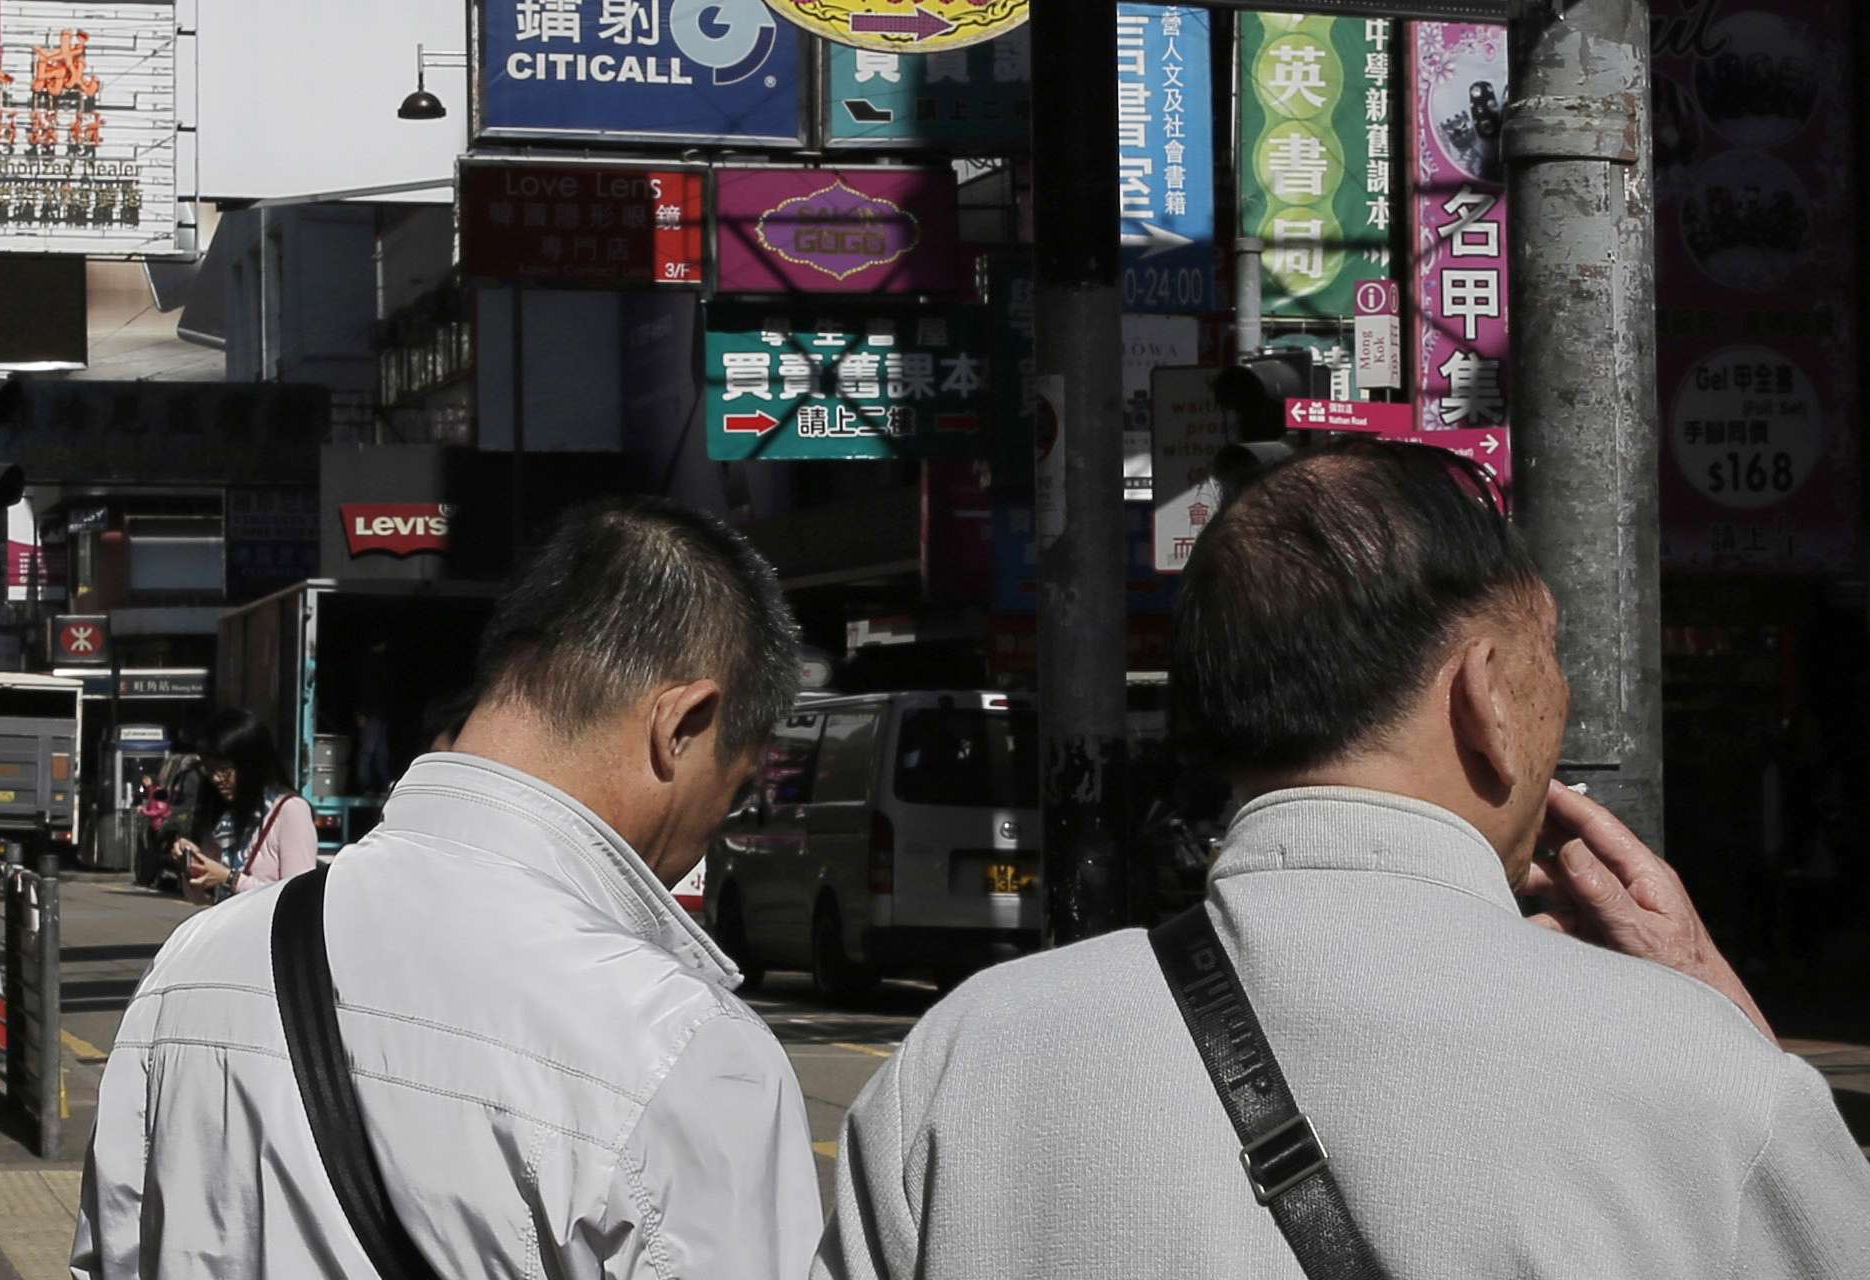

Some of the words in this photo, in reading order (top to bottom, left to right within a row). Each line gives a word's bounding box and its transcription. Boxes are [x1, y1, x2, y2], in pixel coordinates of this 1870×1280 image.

[505, 51, 693, 86] CITICALL
[1436, 183, 1507, 427] 名甲集
[1360, 329, 1373, 370] Mong
[1374, 336, 1386, 363] Kok
[1708, 452, 1795, 493] $168
